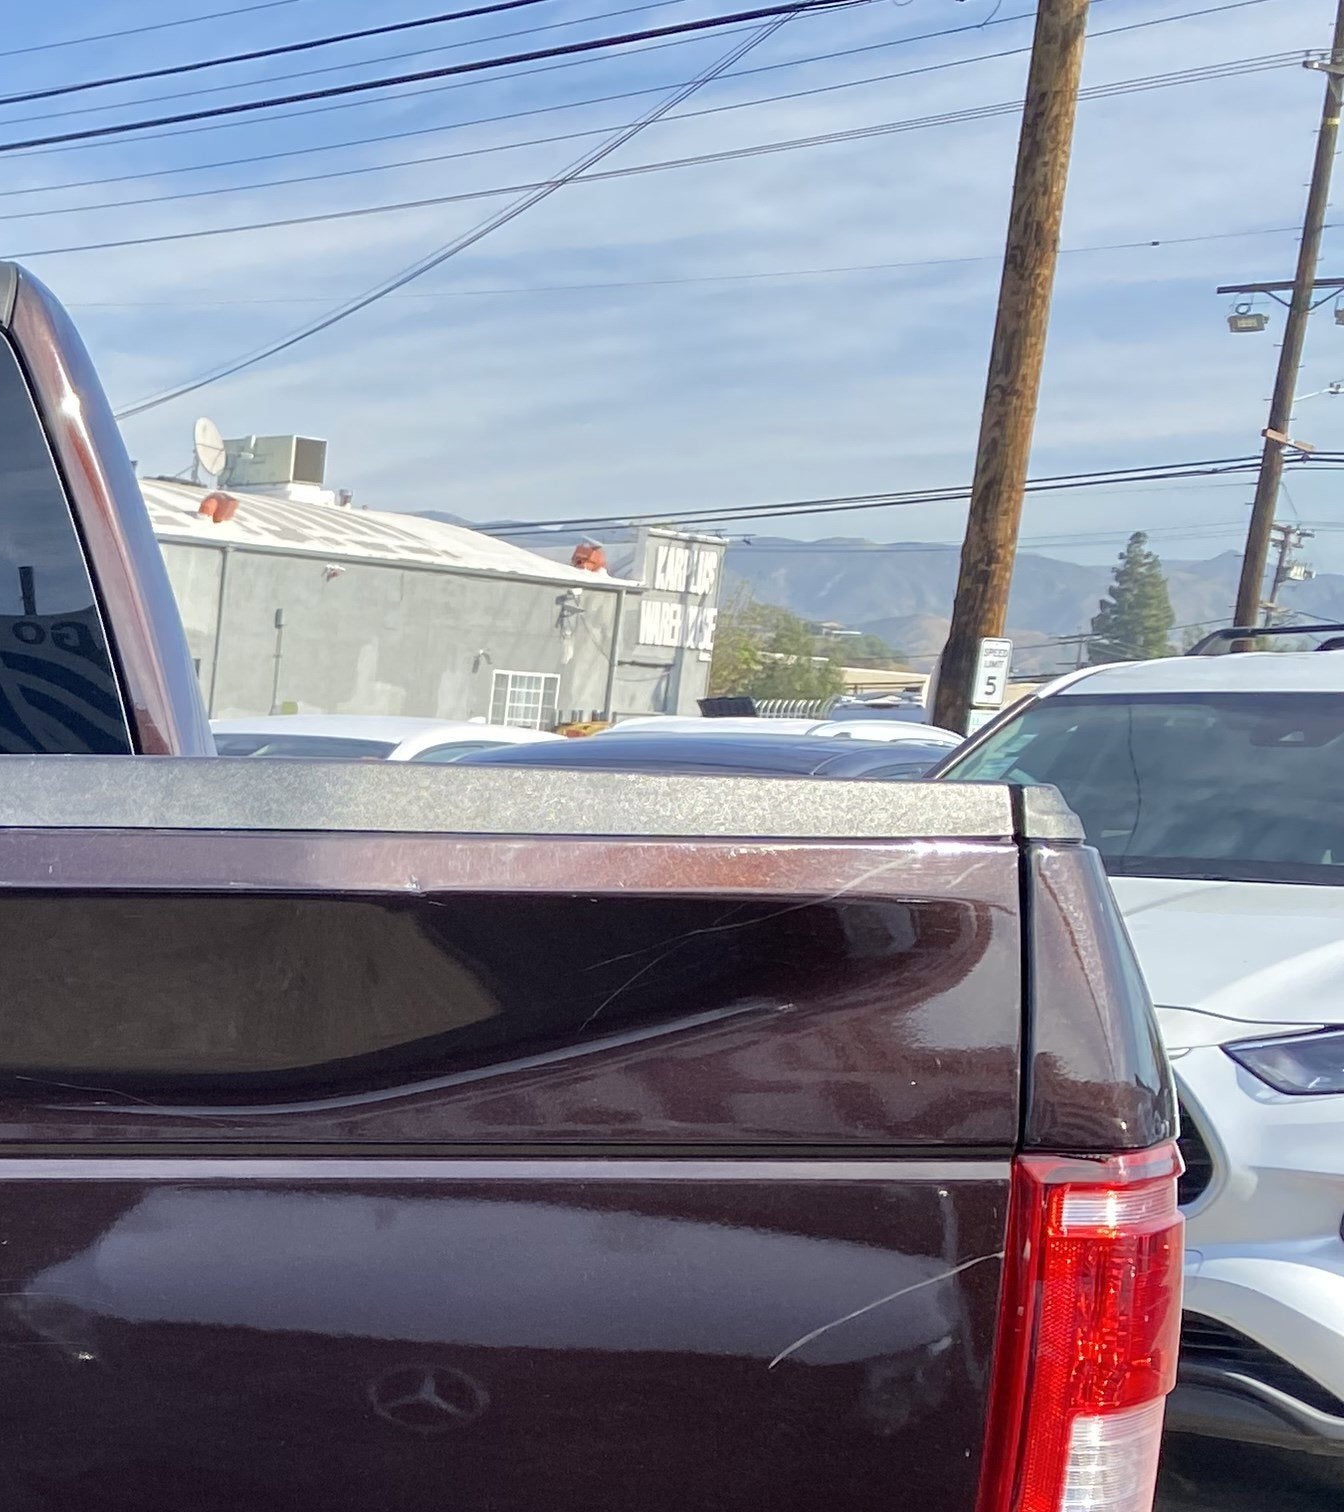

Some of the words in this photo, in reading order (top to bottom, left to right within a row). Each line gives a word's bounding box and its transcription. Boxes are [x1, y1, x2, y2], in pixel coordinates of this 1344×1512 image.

[984, 648, 1008, 657] SPEED
[984, 660, 1004, 669] LIMIT
[985, 676, 997, 695] 5
